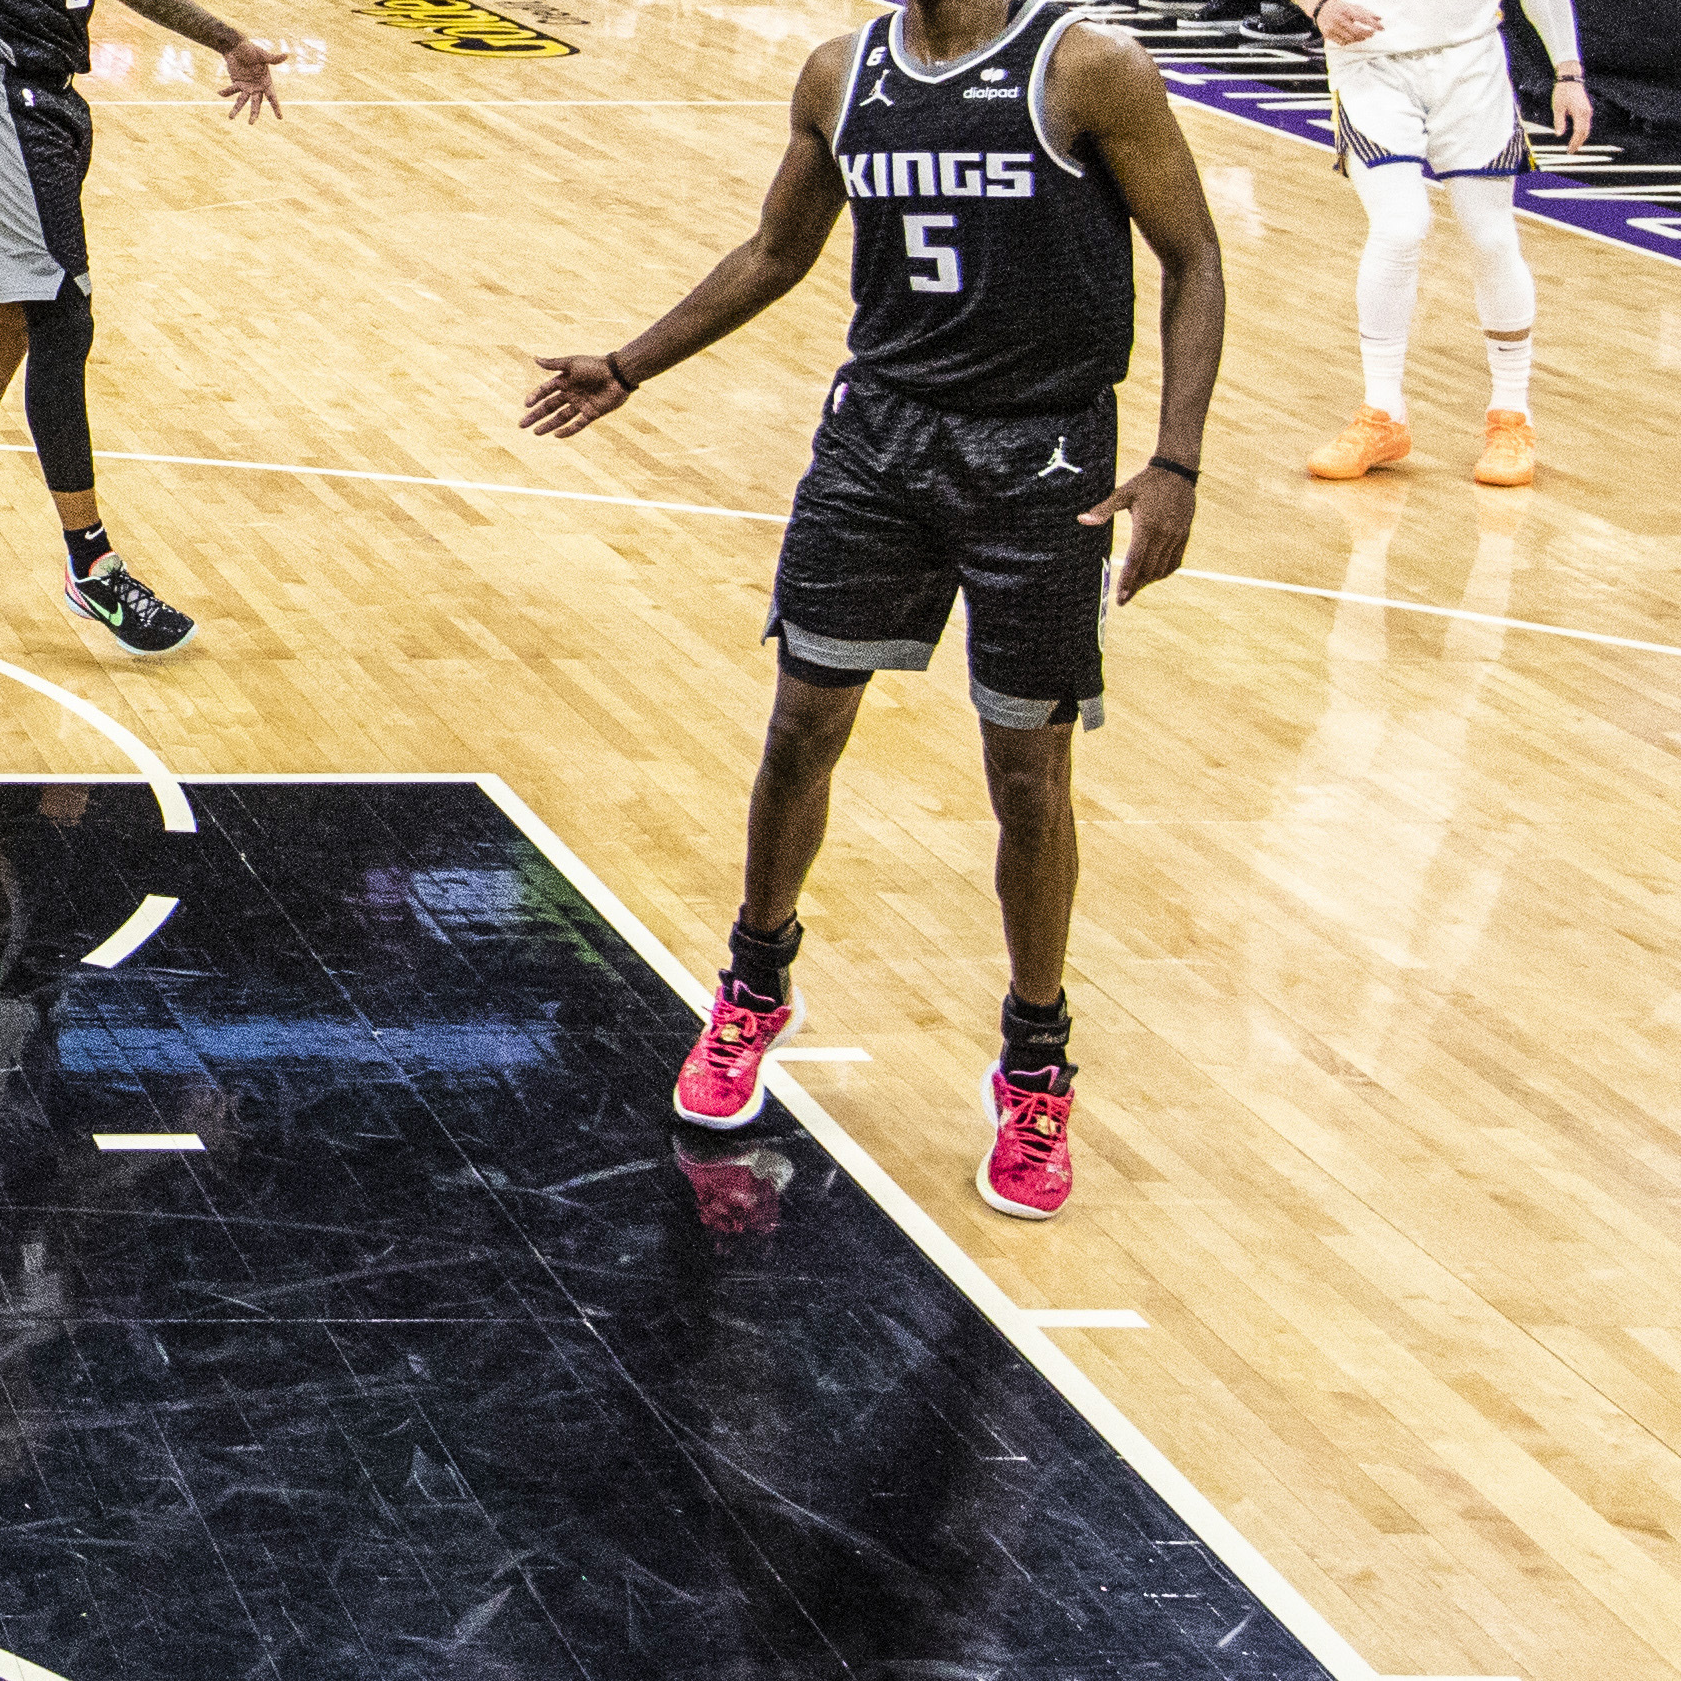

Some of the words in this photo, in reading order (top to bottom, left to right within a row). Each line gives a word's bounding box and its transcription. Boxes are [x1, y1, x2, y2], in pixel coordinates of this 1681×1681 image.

[867, 46, 886, 66] 6
[963, 85, 1020, 102] dialpad
[840, 151, 1033, 198] KINGS
[902, 214, 961, 293] 5
